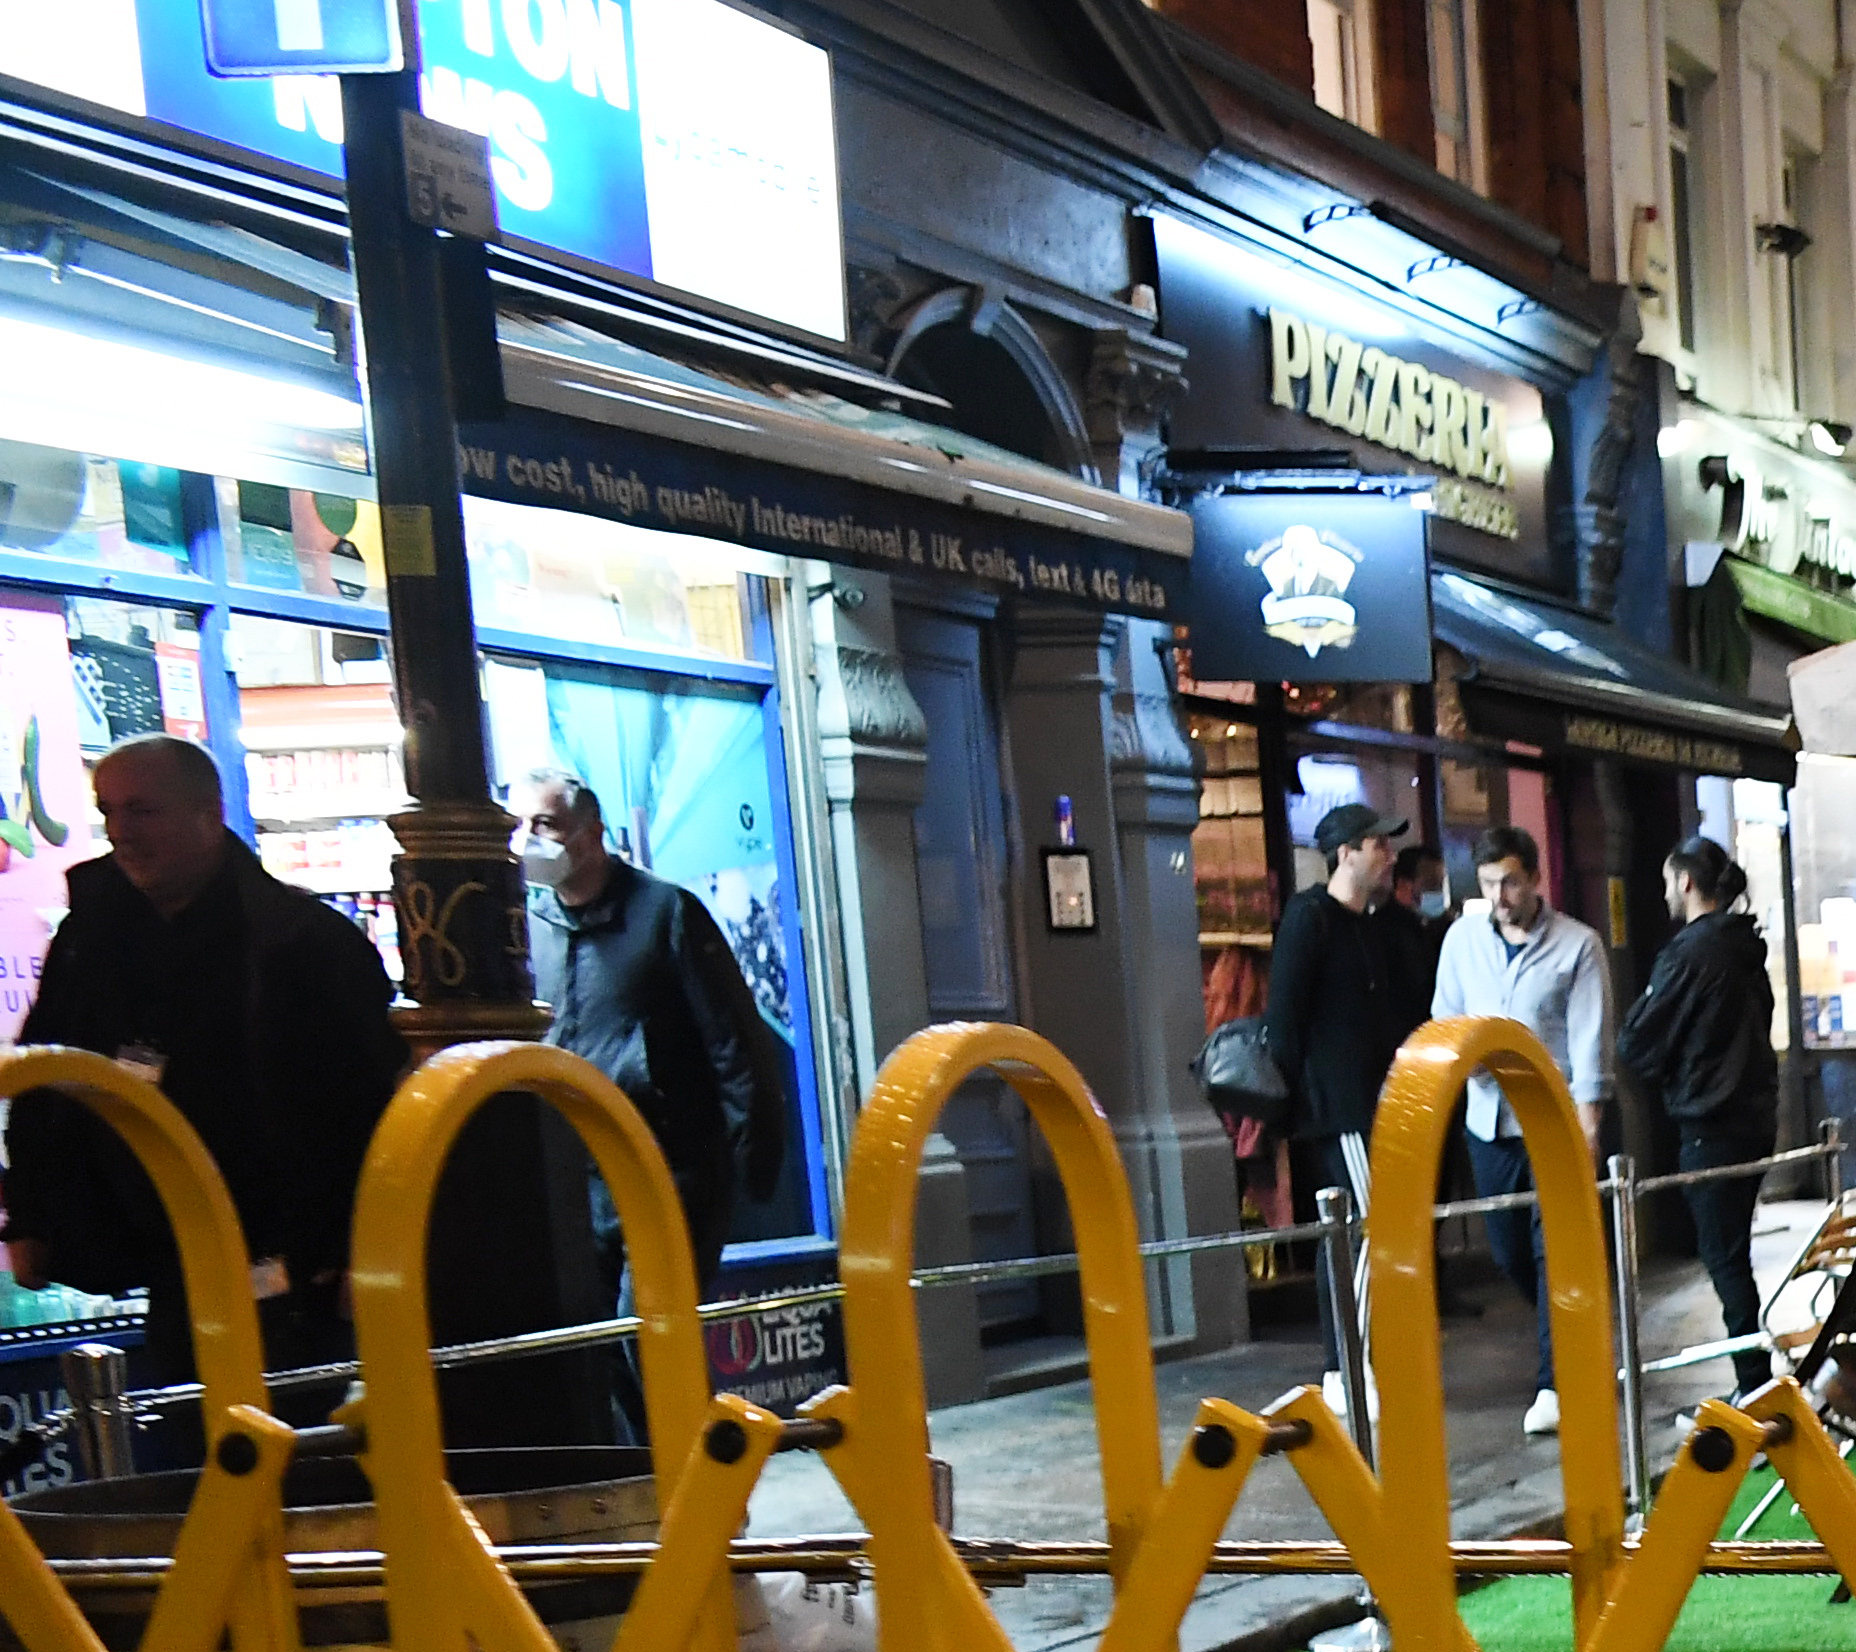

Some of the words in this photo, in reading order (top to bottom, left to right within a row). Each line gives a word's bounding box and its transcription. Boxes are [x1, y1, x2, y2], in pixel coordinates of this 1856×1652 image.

[1267, 304, 1514, 490] PIZZERIA
[506, 452, 586, 503] cost,
[587, 461, 648, 517] high
[656, 486, 746, 536] quality
[753, 497, 900, 558] International
[930, 532, 967, 572] UK
[1029, 554, 1071, 593] text
